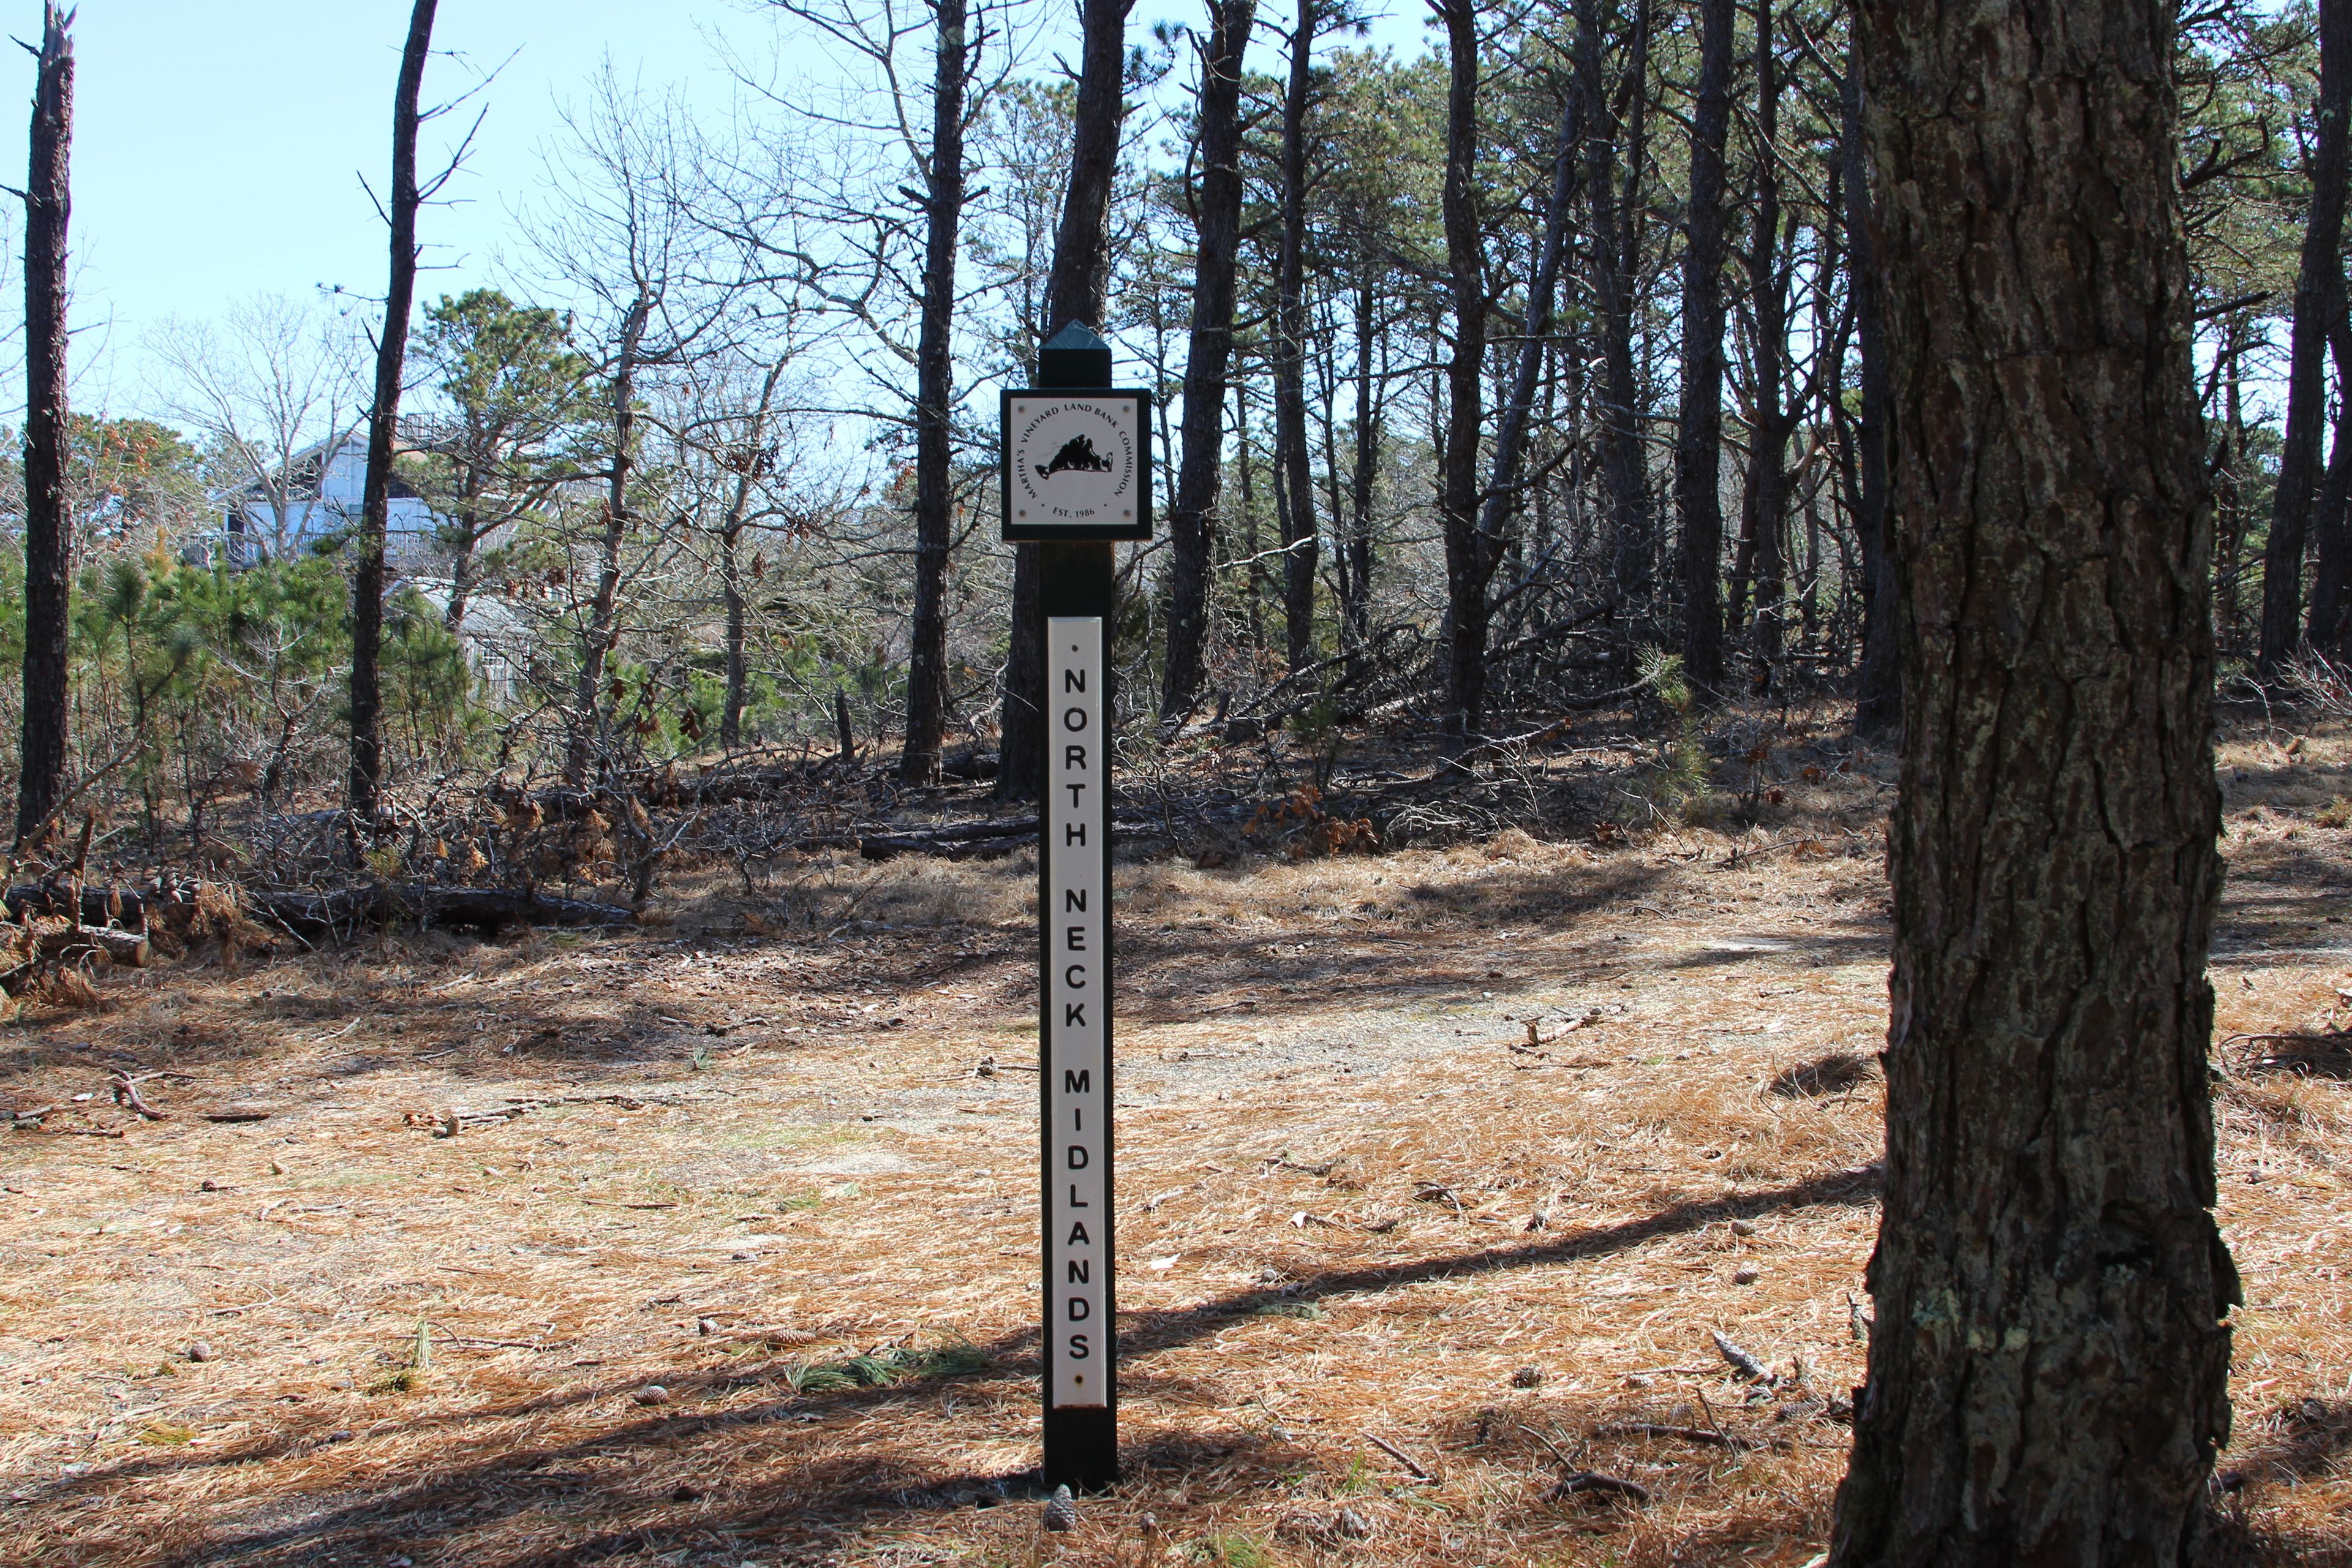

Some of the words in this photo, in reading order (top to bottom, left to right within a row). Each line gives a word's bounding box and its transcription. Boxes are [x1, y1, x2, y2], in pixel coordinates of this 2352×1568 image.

[1021, 407, 1059, 443] VINEYARD
[1065, 403, 1092, 412] LAND
[1095, 408, 1118, 428] BANK
[1017, 449, 1038, 499] MARTHA'S
[1114, 431, 1133, 497] COMMISSION
[1052, 507, 1072, 518] EST.
[1076, 508, 1095, 518] 1986
[1064, 668, 1087, 847] NORTH
[1065, 888, 1087, 1028] NECK
[1065, 1069, 1090, 1360] MIDLANDS
